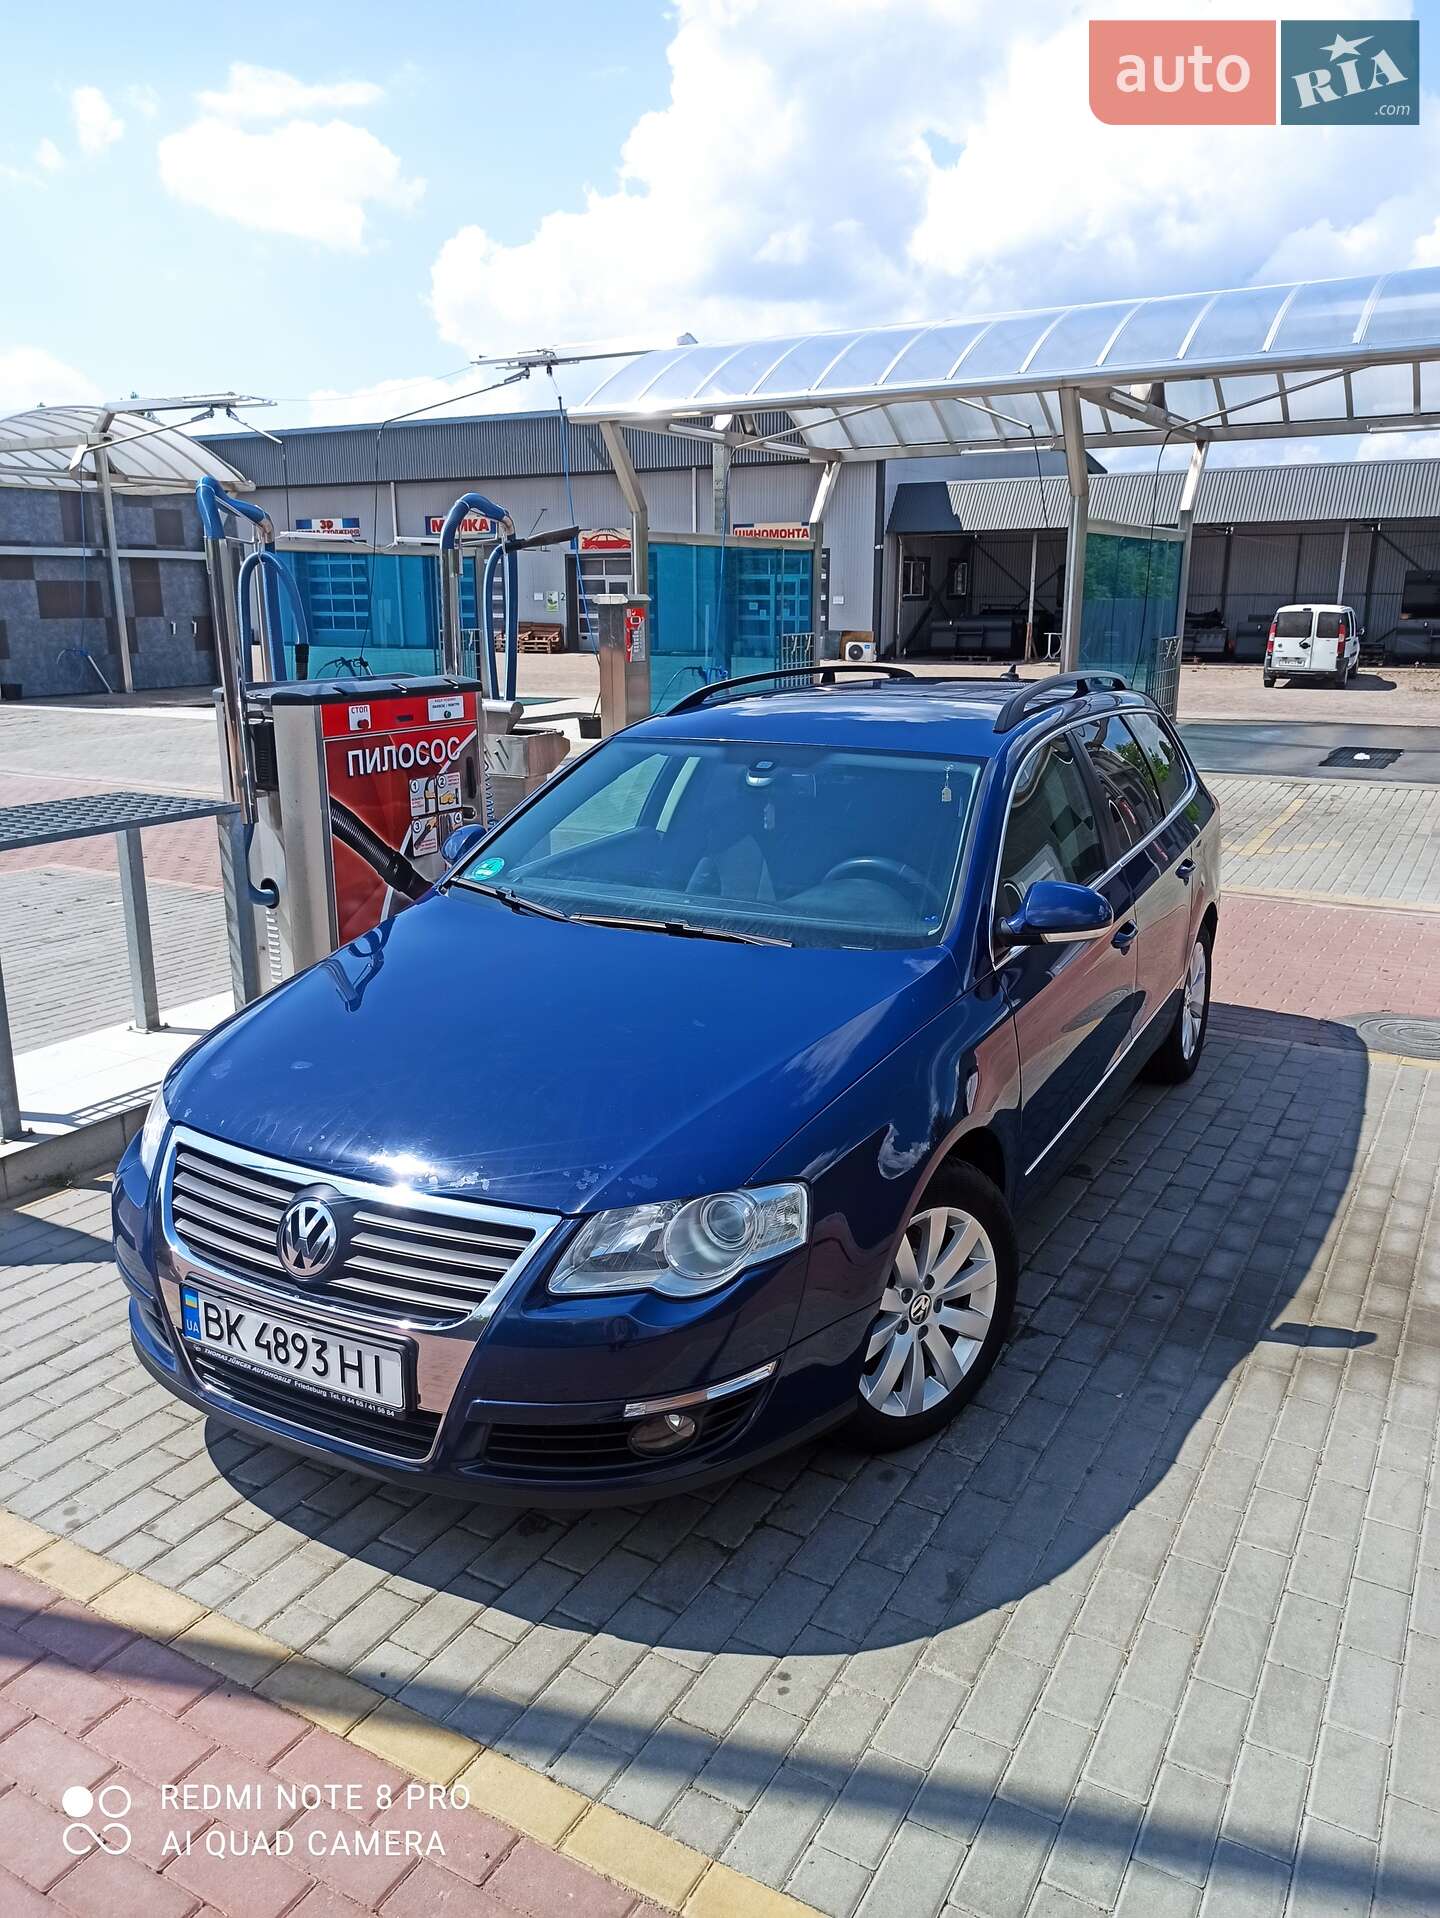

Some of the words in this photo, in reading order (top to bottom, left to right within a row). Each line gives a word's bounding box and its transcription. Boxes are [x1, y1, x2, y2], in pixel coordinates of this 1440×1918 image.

[735, 528, 810, 539] ШИНОМОНТА
[351, 706, 368, 714] СТОП
[347, 736, 461, 777] ПИЛОСОС
[186, 1319, 200, 1334] UA
[254, 1322, 329, 1377] 4893
[204, 1349, 228, 1361] THOMAS
[251, 1366, 292, 1384] AUTOMOBILE
[294, 1380, 327, 1397] Friedeburg
